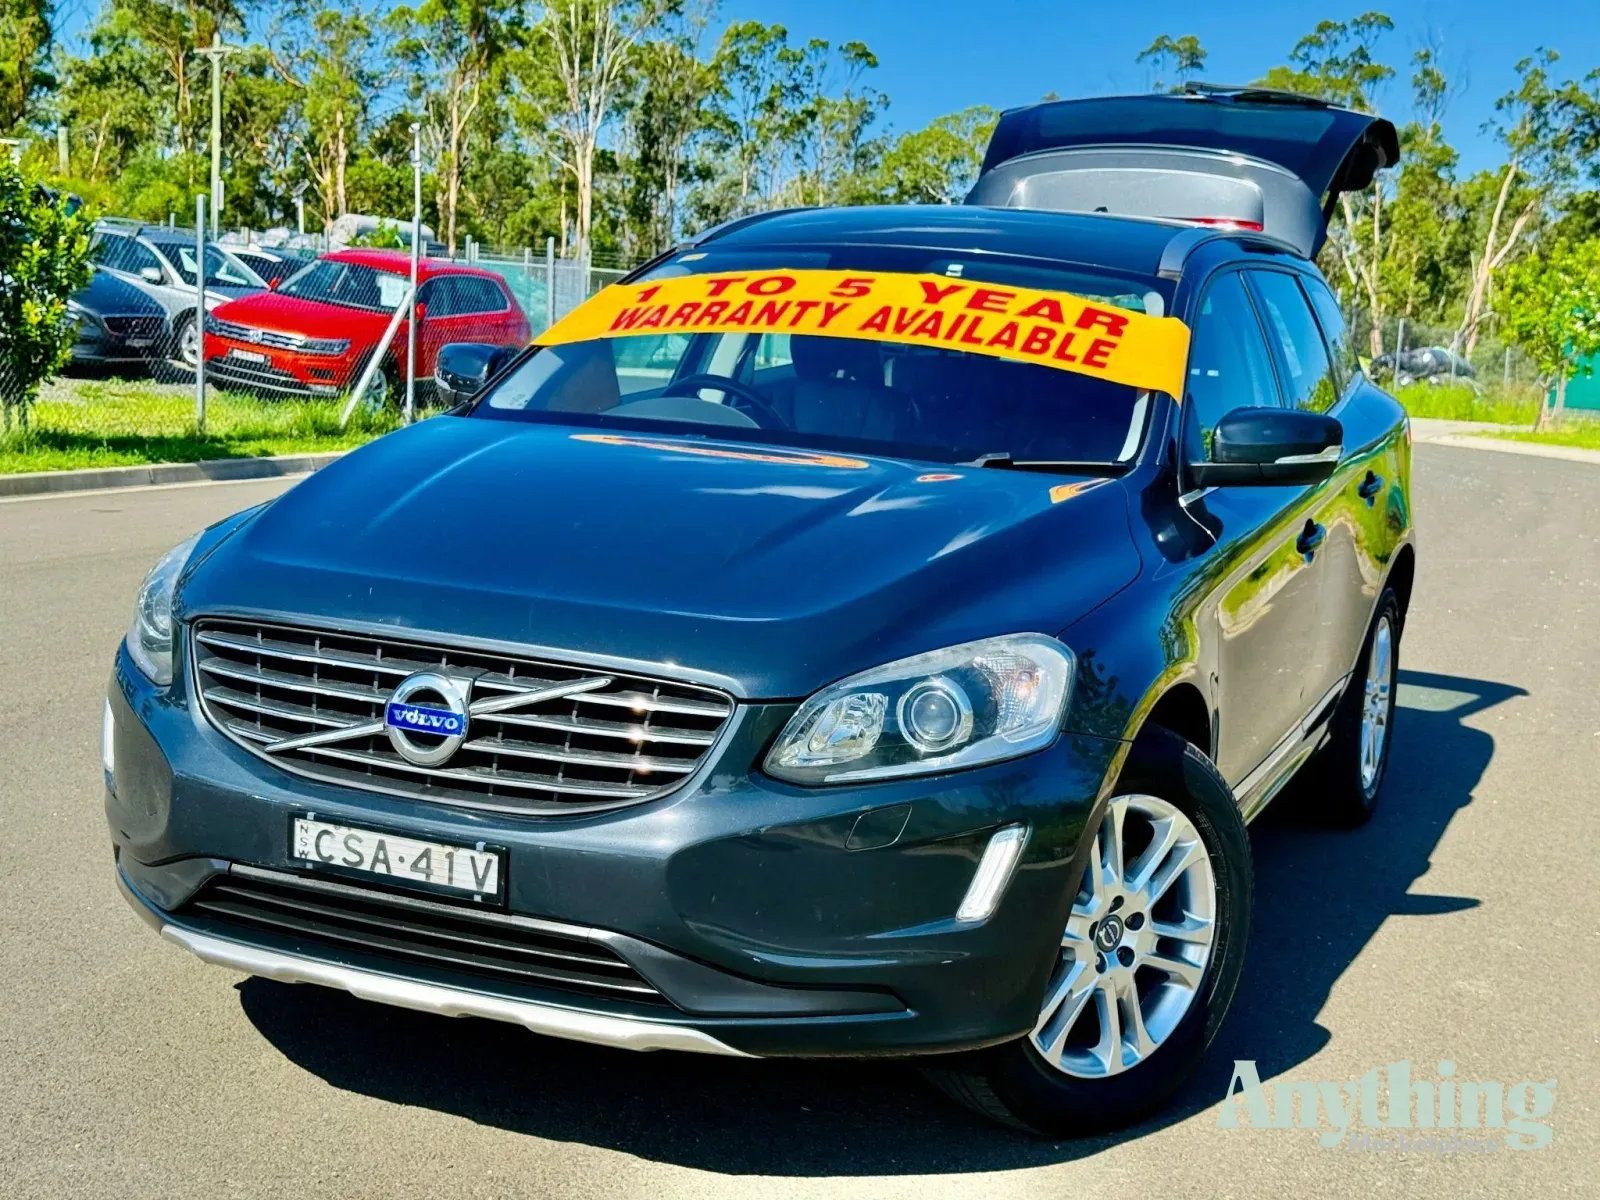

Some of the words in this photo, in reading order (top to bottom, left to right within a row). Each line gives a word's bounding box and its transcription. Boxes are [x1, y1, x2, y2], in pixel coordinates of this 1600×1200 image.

[610, 300, 850, 331] WARRANTY
[857, 305, 1119, 369] AVAILABLE
[636, 286, 662, 303] 1
[707, 278, 798, 298] TO
[830, 278, 875, 298] 5
[920, 281, 1129, 338] YEAR
[392, 707, 459, 730] VOLVO
